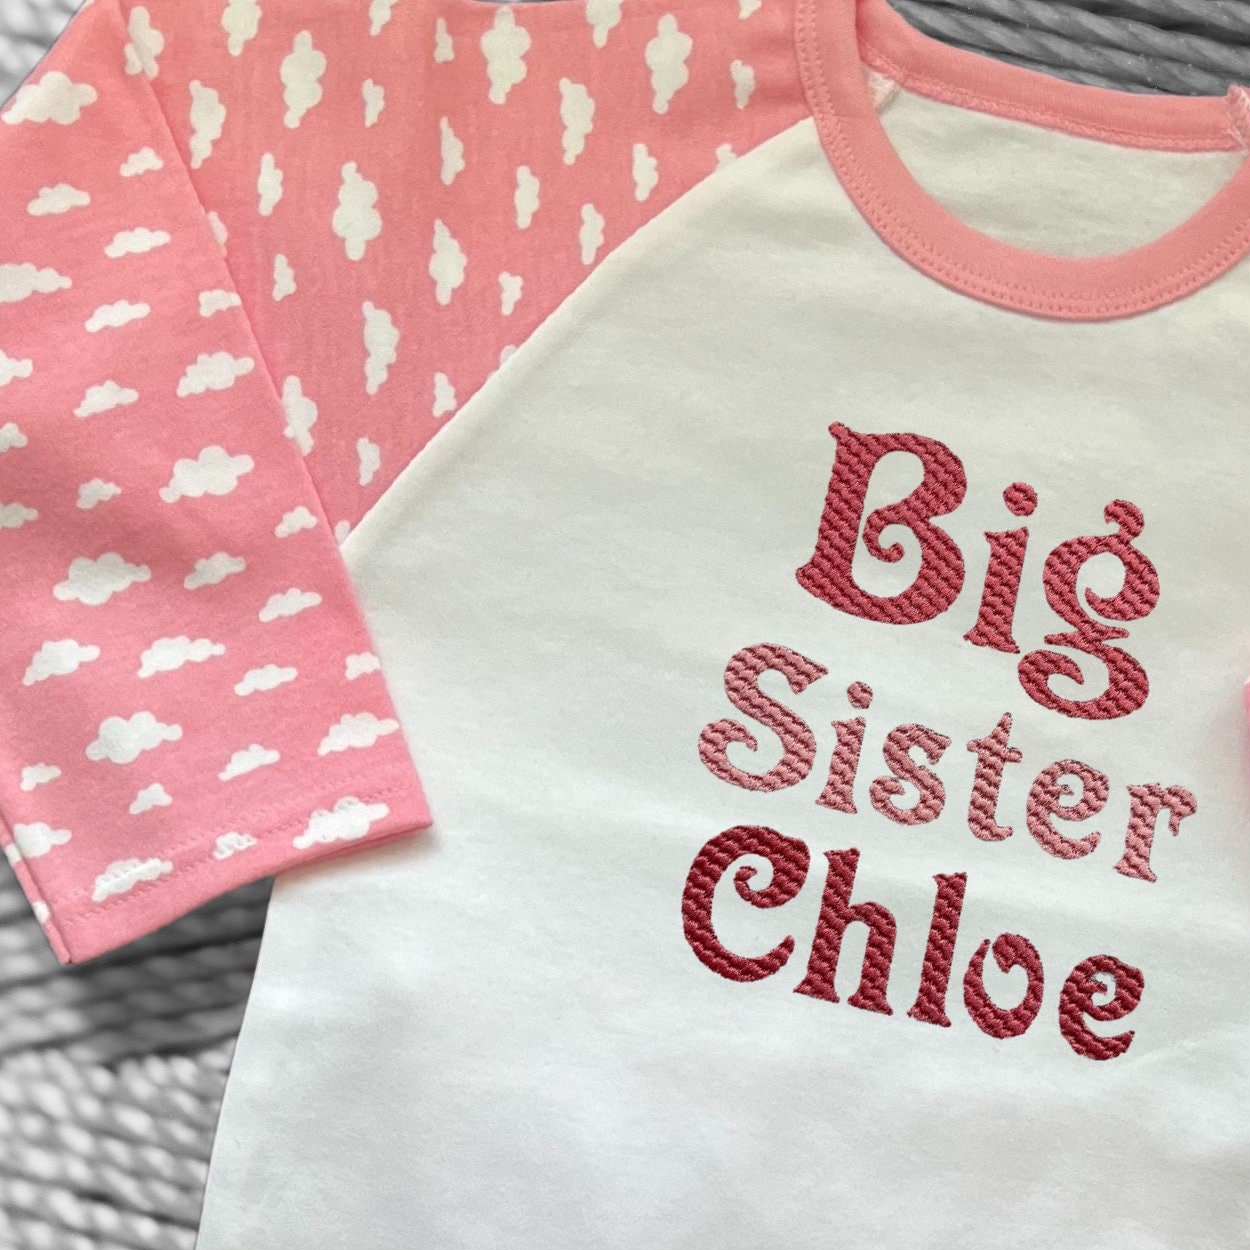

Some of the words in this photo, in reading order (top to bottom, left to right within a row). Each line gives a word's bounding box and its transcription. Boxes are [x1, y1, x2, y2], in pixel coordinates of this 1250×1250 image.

[796, 421, 1160, 720] Big
[698, 642, 1197, 881] Sister
[682, 825, 1145, 1061] Chloe
